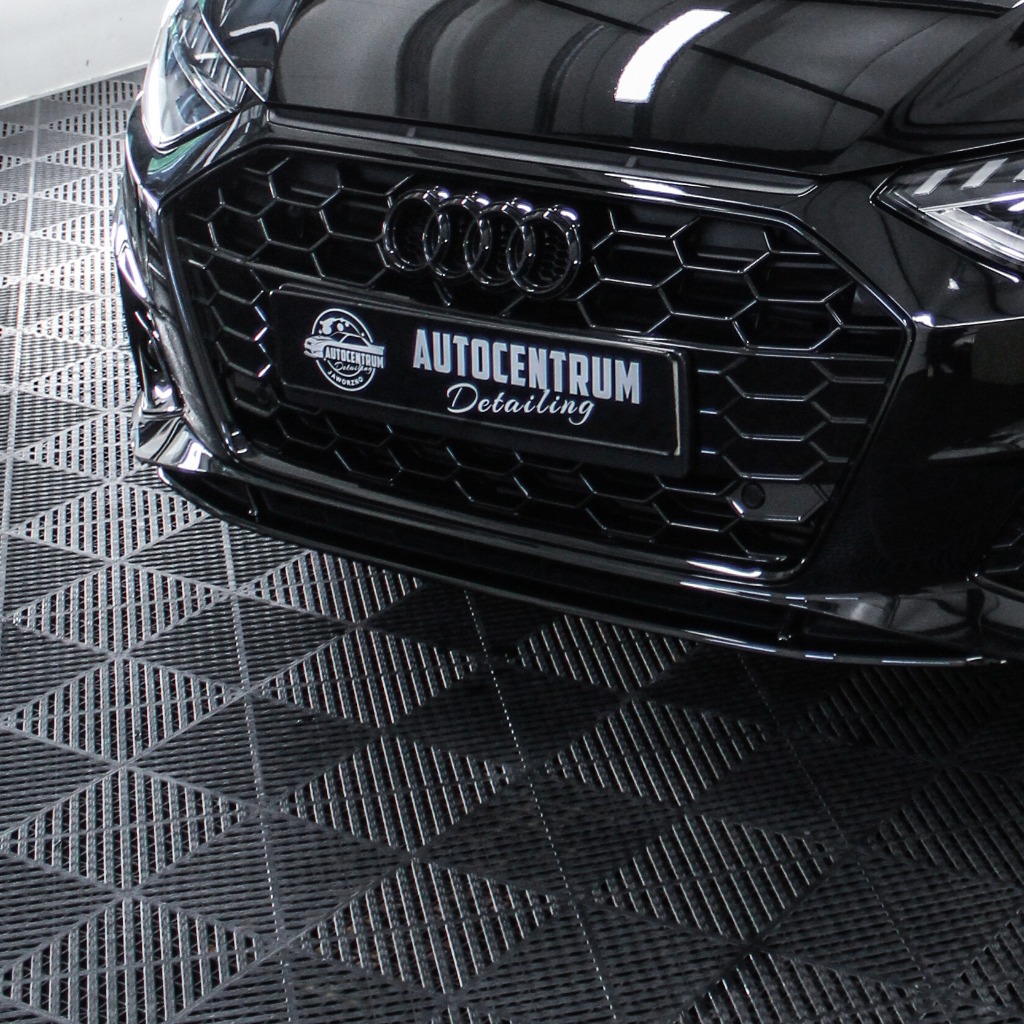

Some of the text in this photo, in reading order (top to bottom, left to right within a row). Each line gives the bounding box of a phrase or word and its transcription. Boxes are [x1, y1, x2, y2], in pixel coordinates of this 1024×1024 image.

[325, 346, 384, 369] AUTOCENTRUM
[412, 328, 641, 405] AUTOCENTRUM
[327, 370, 364, 386] JAWORZNO
[446, 383, 595, 425] Detailing
